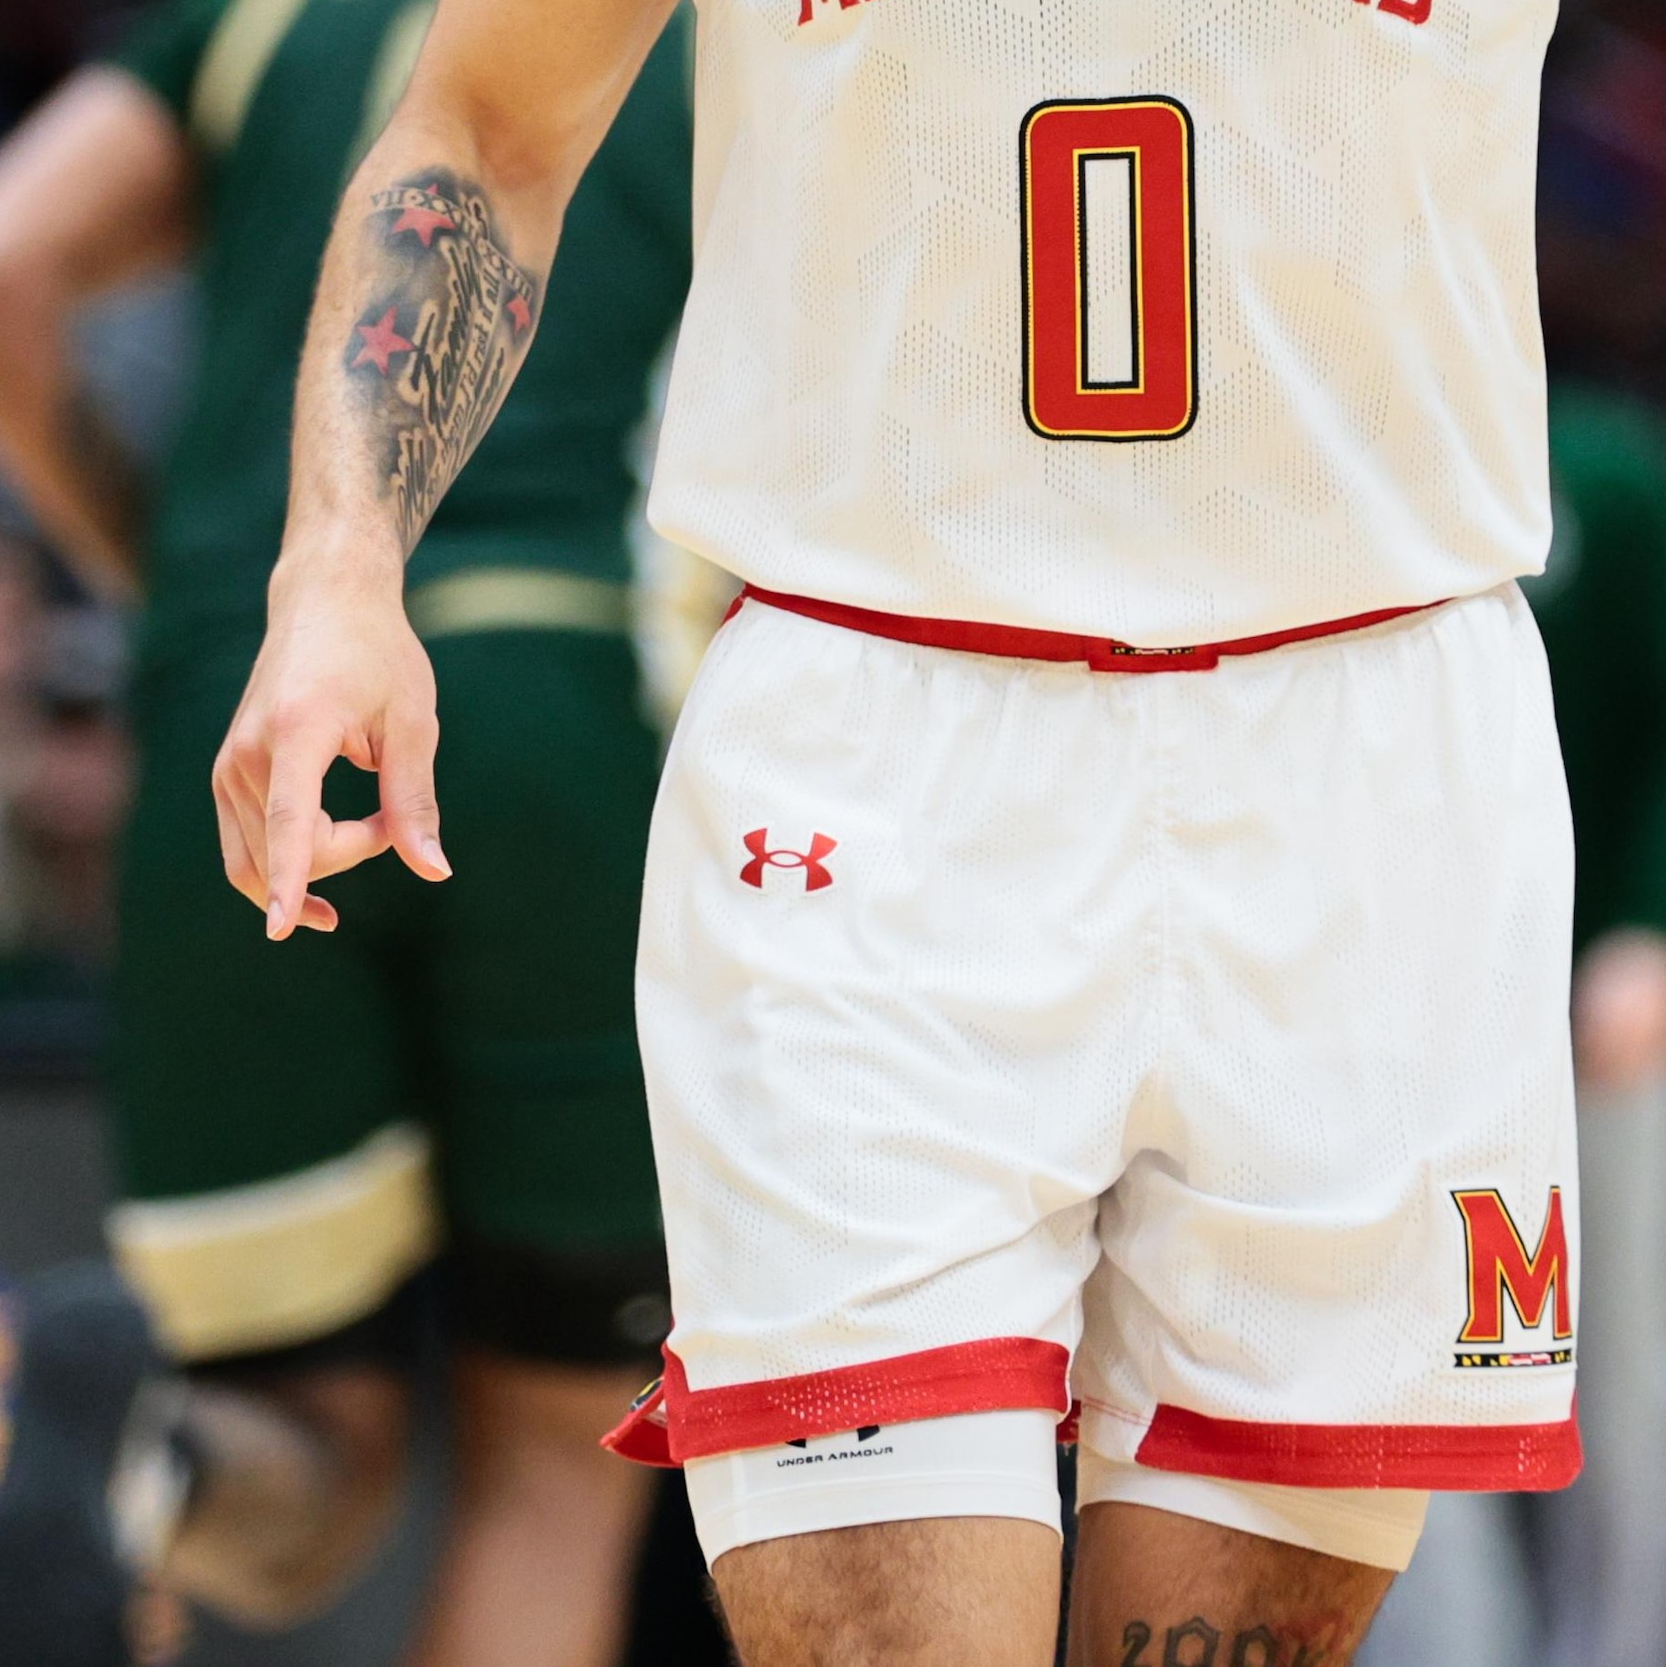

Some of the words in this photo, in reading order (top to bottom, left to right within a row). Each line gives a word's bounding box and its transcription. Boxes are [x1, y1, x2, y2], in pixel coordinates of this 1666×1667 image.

[1019, 94, 1198, 442] 0
[1450, 1186, 1572, 1343] M
[776, 1454, 823, 1467] UNDER
[828, 1446, 894, 1462] ARMOUR
